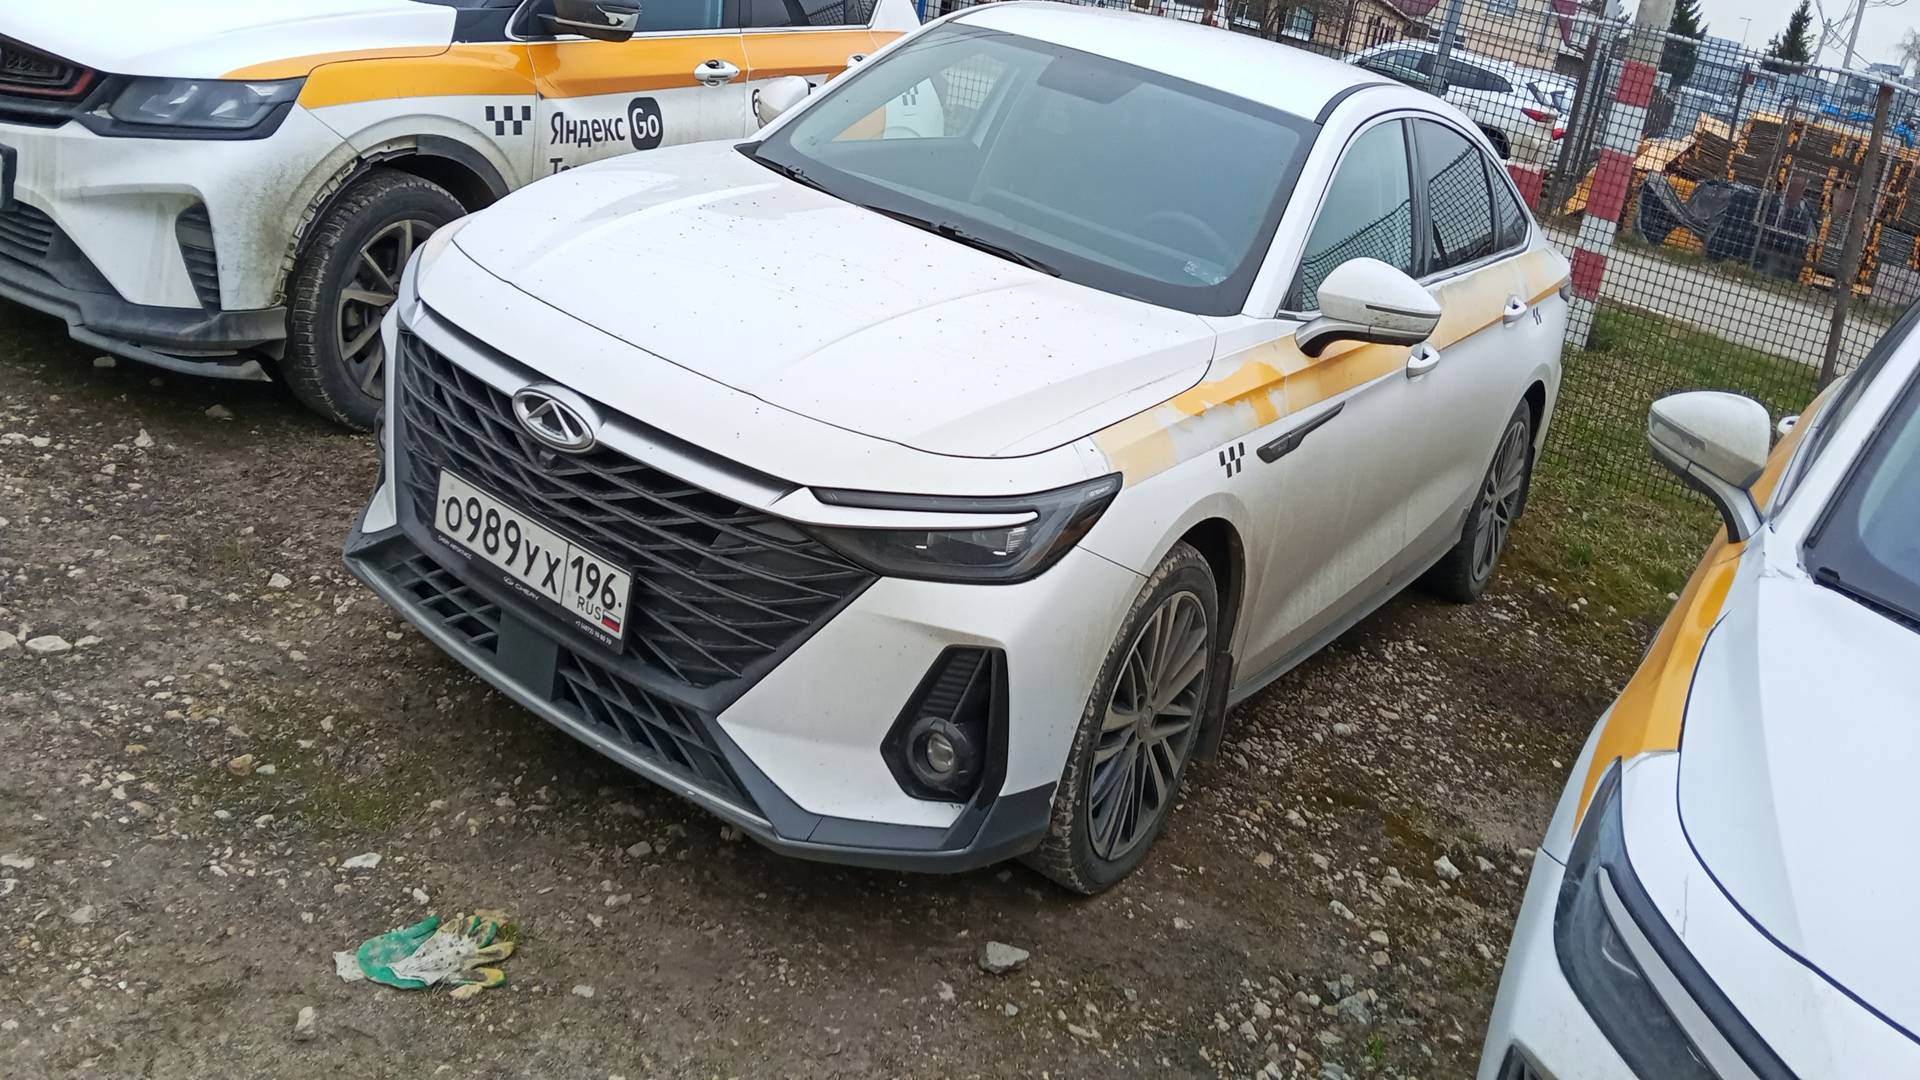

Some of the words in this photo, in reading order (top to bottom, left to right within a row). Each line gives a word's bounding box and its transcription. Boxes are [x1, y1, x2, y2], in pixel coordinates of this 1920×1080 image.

[551, 112, 625, 147] Яндекс
[633, 108, 660, 139] Go
[571, 555, 617, 611] 196
[577, 595, 602, 621] RUS
